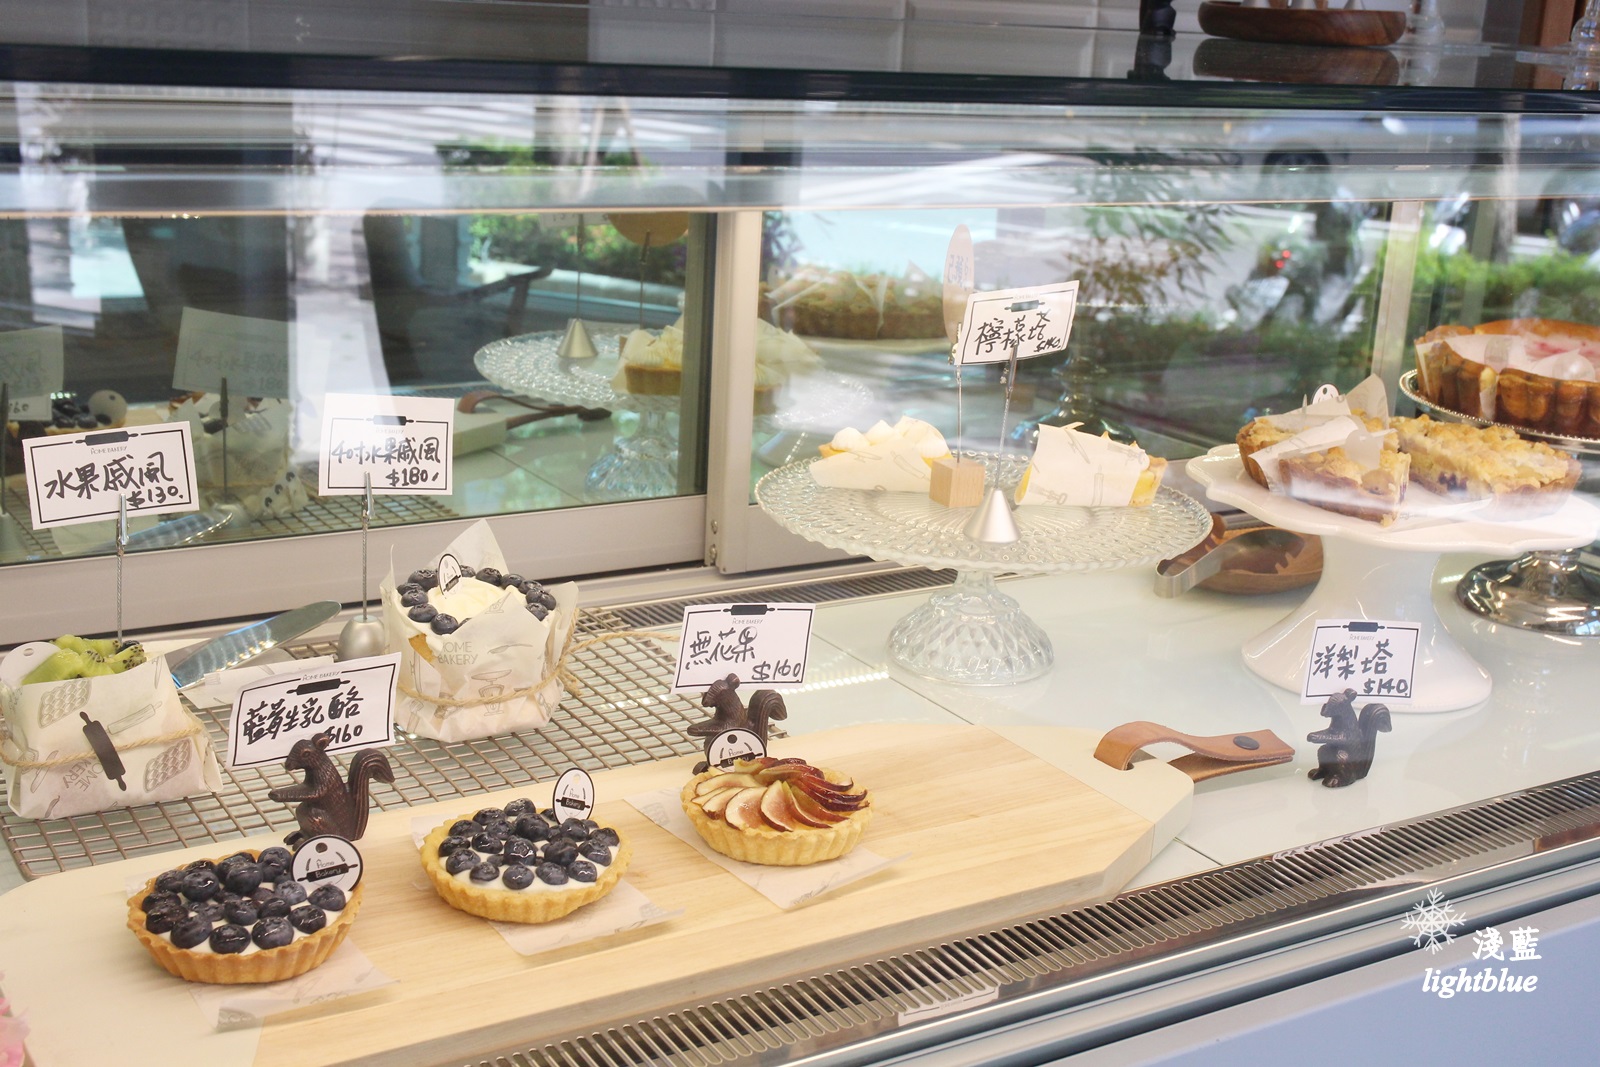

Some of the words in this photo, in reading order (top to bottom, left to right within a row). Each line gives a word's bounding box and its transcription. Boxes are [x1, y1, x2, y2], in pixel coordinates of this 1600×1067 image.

[975, 308, 1051, 355] 檸檬塔
[44, 451, 173, 499] 水果戚風
[685, 626, 758, 670] 無花果
[1313, 639, 1394, 680] 洋梨塔
[242, 685, 364, 745] 藍莓生乳酪
[75, 762, 104, 792] OME
